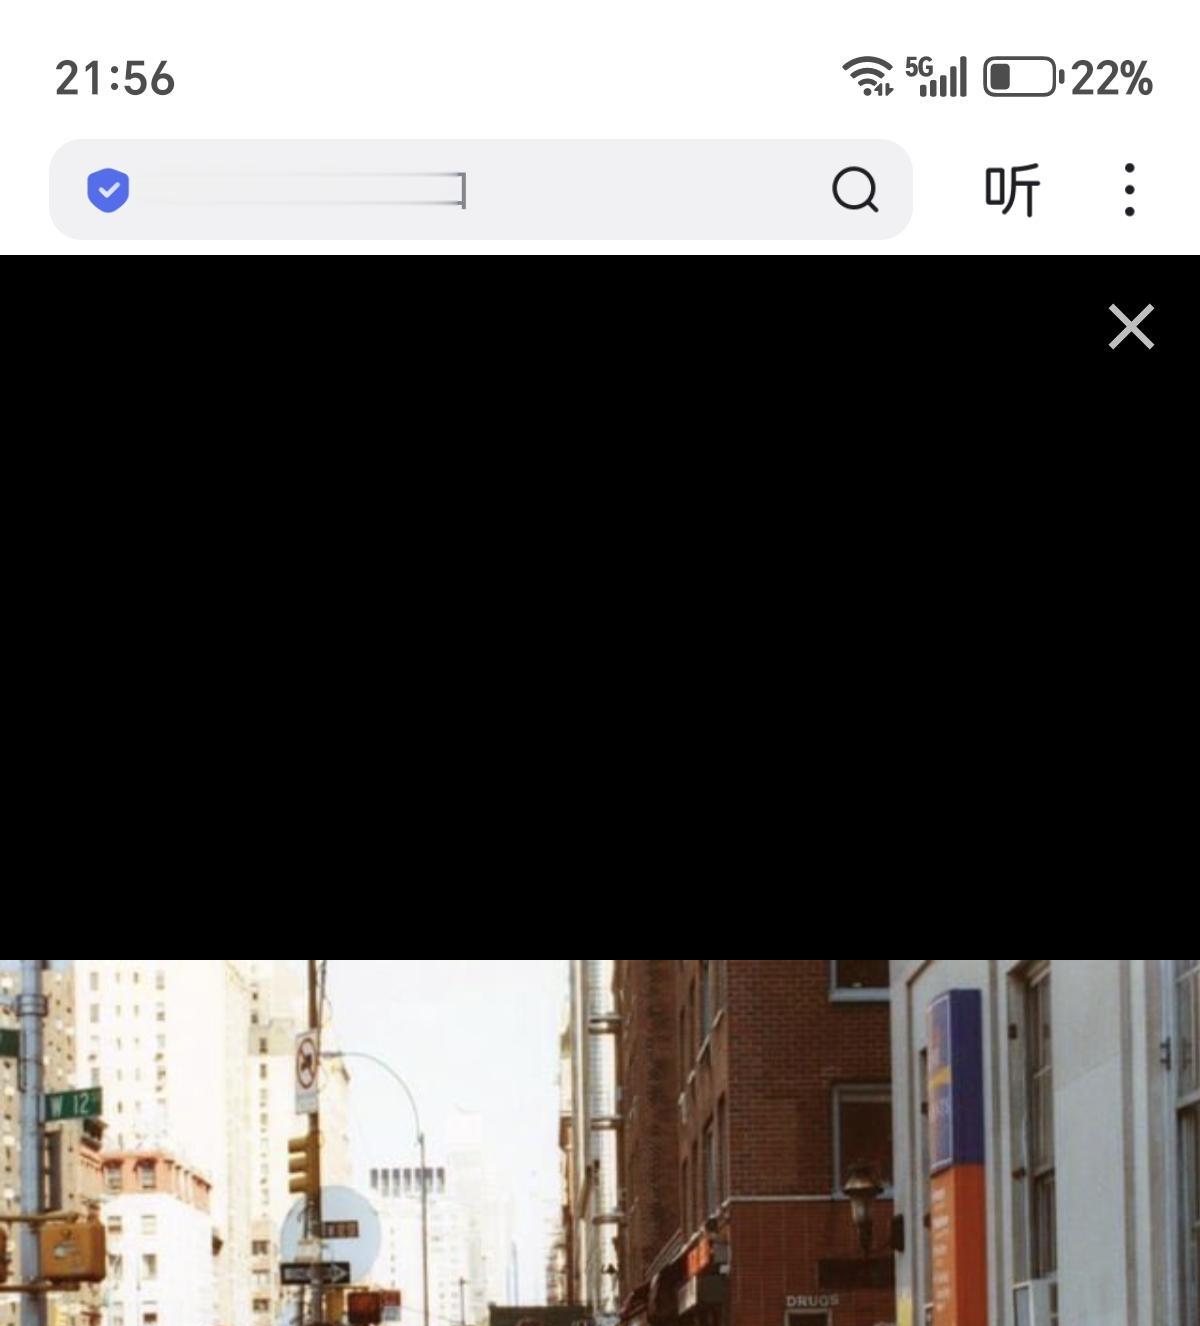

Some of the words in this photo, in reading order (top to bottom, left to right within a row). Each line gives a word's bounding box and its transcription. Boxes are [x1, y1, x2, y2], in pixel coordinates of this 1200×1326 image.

[50, 1095, 64, 1117] W
[73, 1092, 90, 1115] 12
[786, 1293, 839, 1307] DRUGS
